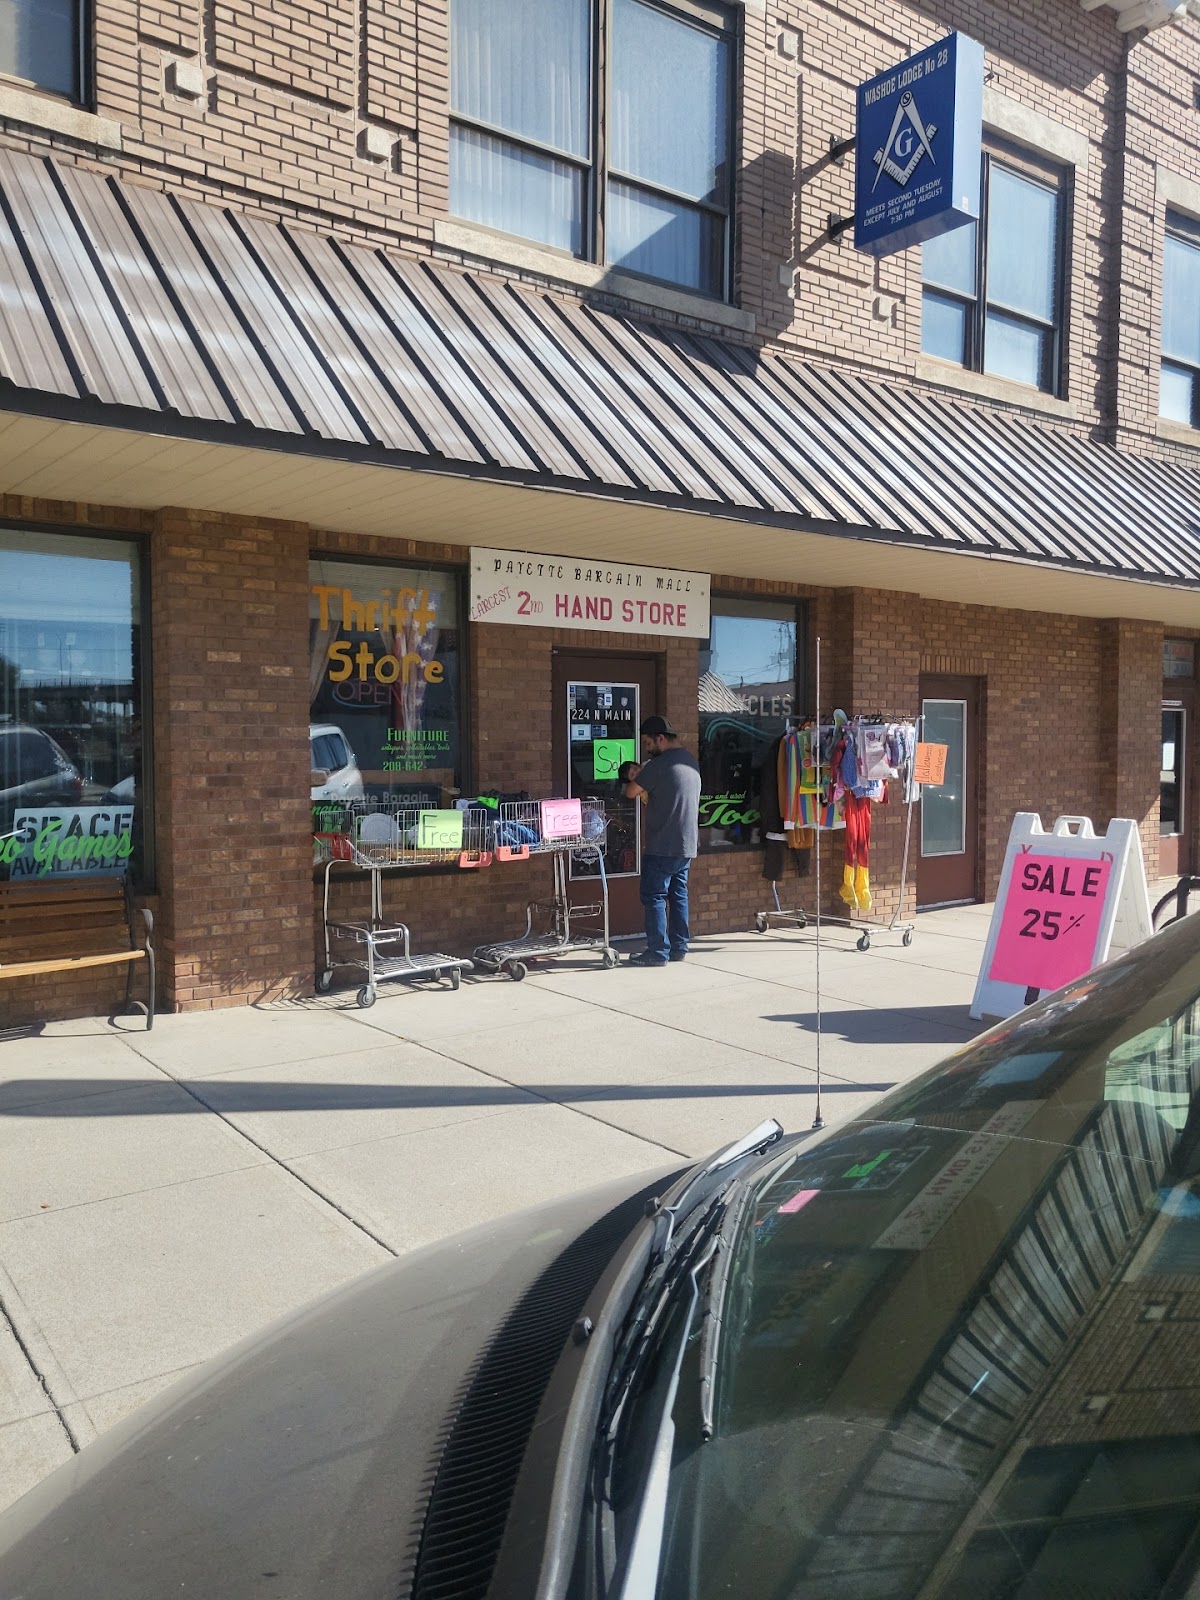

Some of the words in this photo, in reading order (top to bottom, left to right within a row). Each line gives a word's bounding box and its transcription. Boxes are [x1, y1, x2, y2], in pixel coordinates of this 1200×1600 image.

[864, 77, 896, 107] WASHOE
[897, 63, 924, 91] LODGE
[924, 57, 935, 76] No
[936, 48, 949, 70] 28
[894, 126, 914, 158] G
[863, 211, 886, 227] EXCEPT
[886, 204, 901, 218] JULY
[902, 198, 917, 211] AND
[918, 186, 944, 204] AUGUST
[865, 202, 886, 217] MEETS
[887, 192, 912, 209] SECOND
[913, 177, 942, 197] TUESDAY
[890, 213, 903, 225] 7:30
[904, 209, 915, 220] PM
[493, 558, 564, 579] PAYETTE
[574, 567, 643, 587] BARGAIN
[656, 576, 692, 592] MALL
[311, 584, 437, 636] Thrift
[470, 586, 512, 620] LARGEST
[555, 593, 613, 621] HAND
[622, 599, 687, 627] STORE
[327, 640, 444, 684] Store
[335, 680, 403, 705] OPEN
[571, 708, 590, 720] 224
[594, 709, 600, 720] N
[605, 709, 631, 720] MAIN
[595, 745, 622, 774] Sal
[382, 791, 429, 805] Bargain
[16, 813, 132, 843] SPACE
[422, 814, 459, 846] Free
[544, 805, 579, 831] Free
[33, 819, 134, 878] Games
[1021, 862, 1102, 898] SALE
[1019, 908, 1085, 941] 25%
